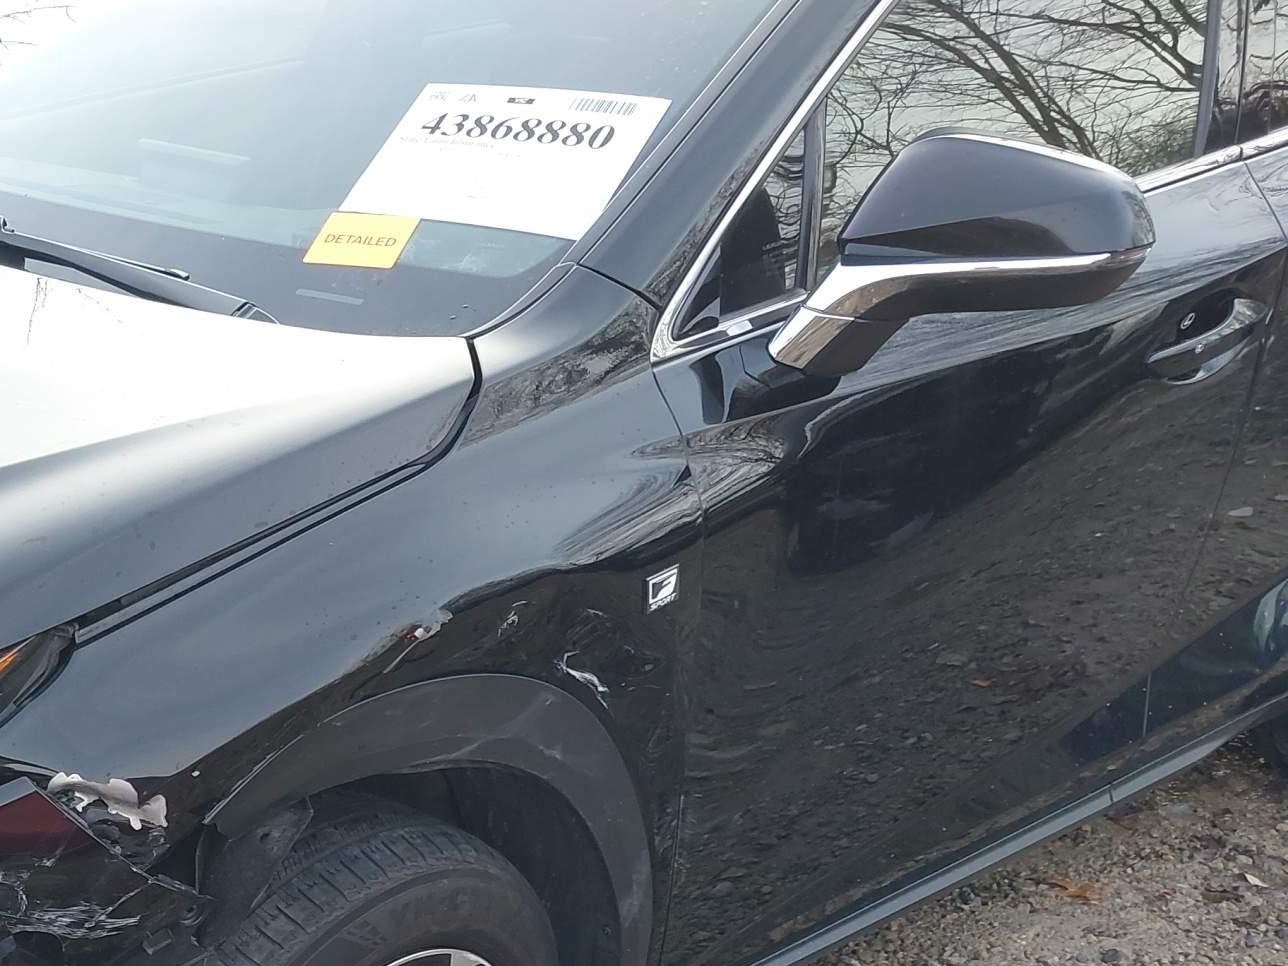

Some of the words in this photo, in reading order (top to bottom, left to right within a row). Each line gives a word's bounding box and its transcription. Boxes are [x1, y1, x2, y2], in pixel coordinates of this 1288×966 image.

[421, 112, 616, 150] 43868880
[324, 233, 397, 247] DETAILED
[649, 592, 678, 611] SPORT
